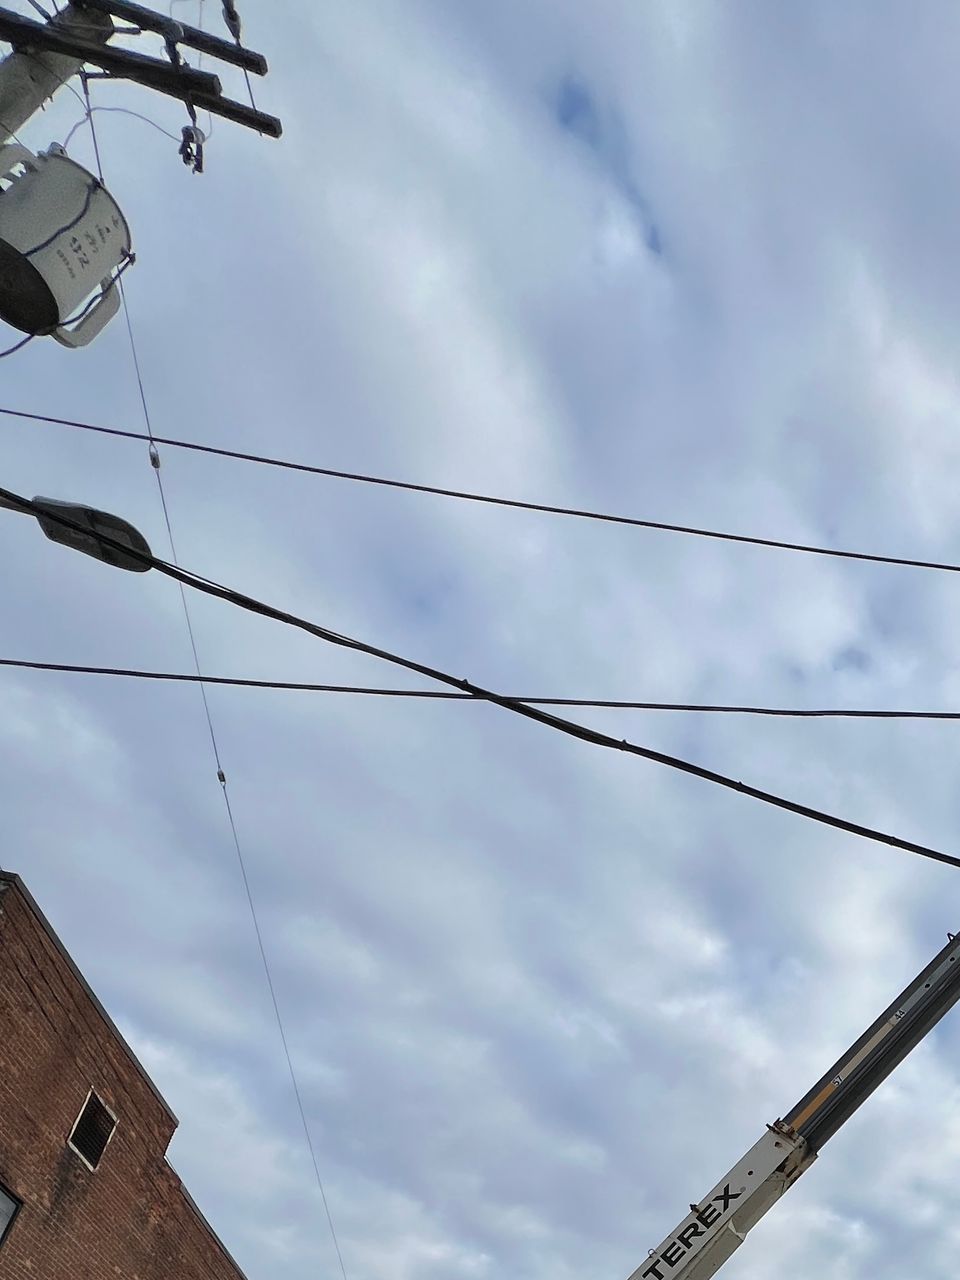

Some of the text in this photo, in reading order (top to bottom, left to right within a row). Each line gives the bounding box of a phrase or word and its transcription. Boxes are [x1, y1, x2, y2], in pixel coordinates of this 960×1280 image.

[895, 1010, 905, 1020] 44
[832, 1075, 842, 1086] 57
[642, 1183, 742, 1280] TEREX
